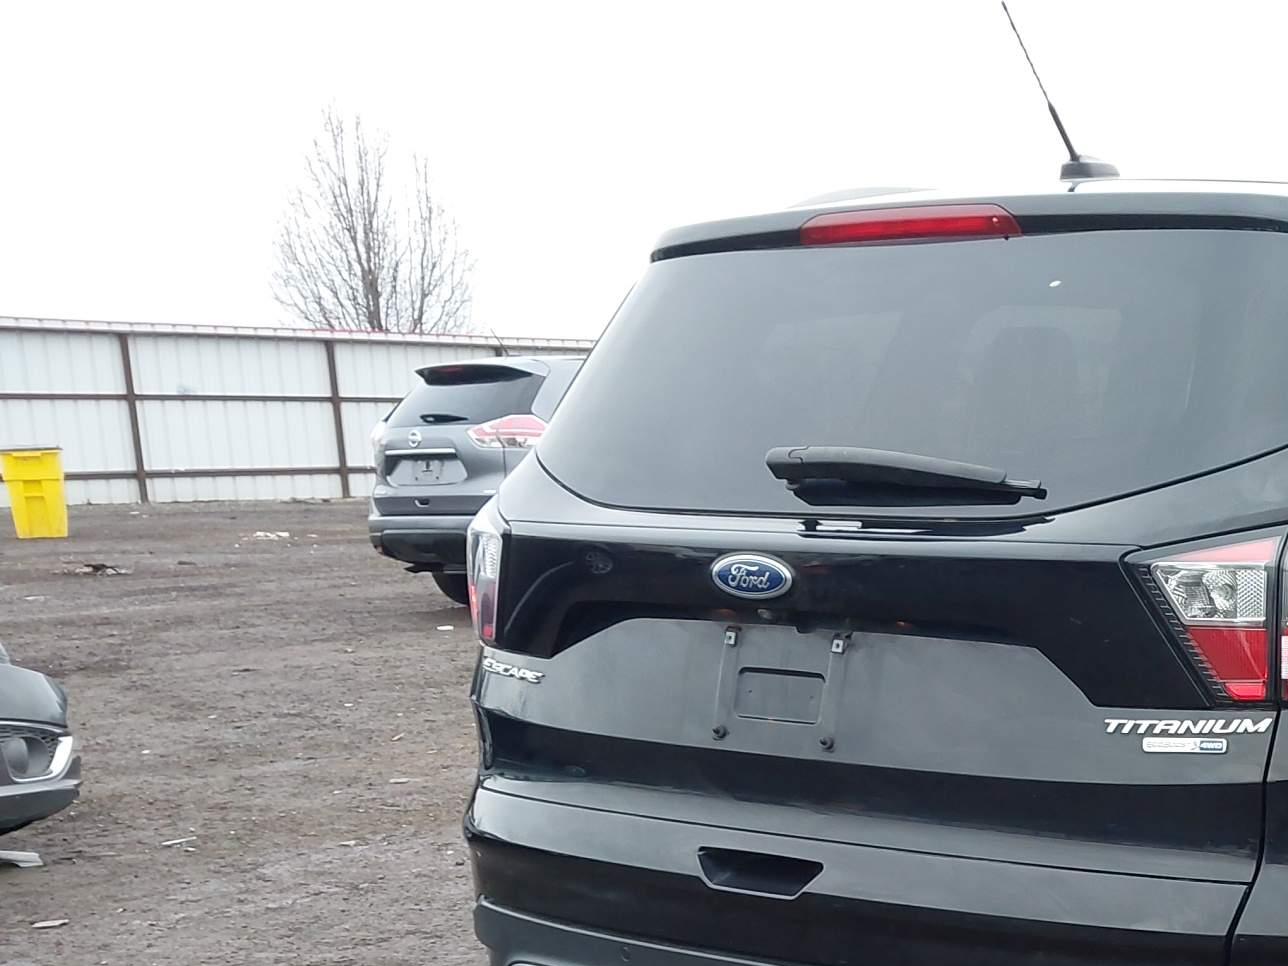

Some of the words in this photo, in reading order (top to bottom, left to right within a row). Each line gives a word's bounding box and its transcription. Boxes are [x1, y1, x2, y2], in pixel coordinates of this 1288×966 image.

[727, 563, 770, 589] Ford
[482, 657, 546, 684] ESCAPE
[1104, 718, 1273, 735] TITANIUM
[1199, 742, 1223, 750] 4WD
